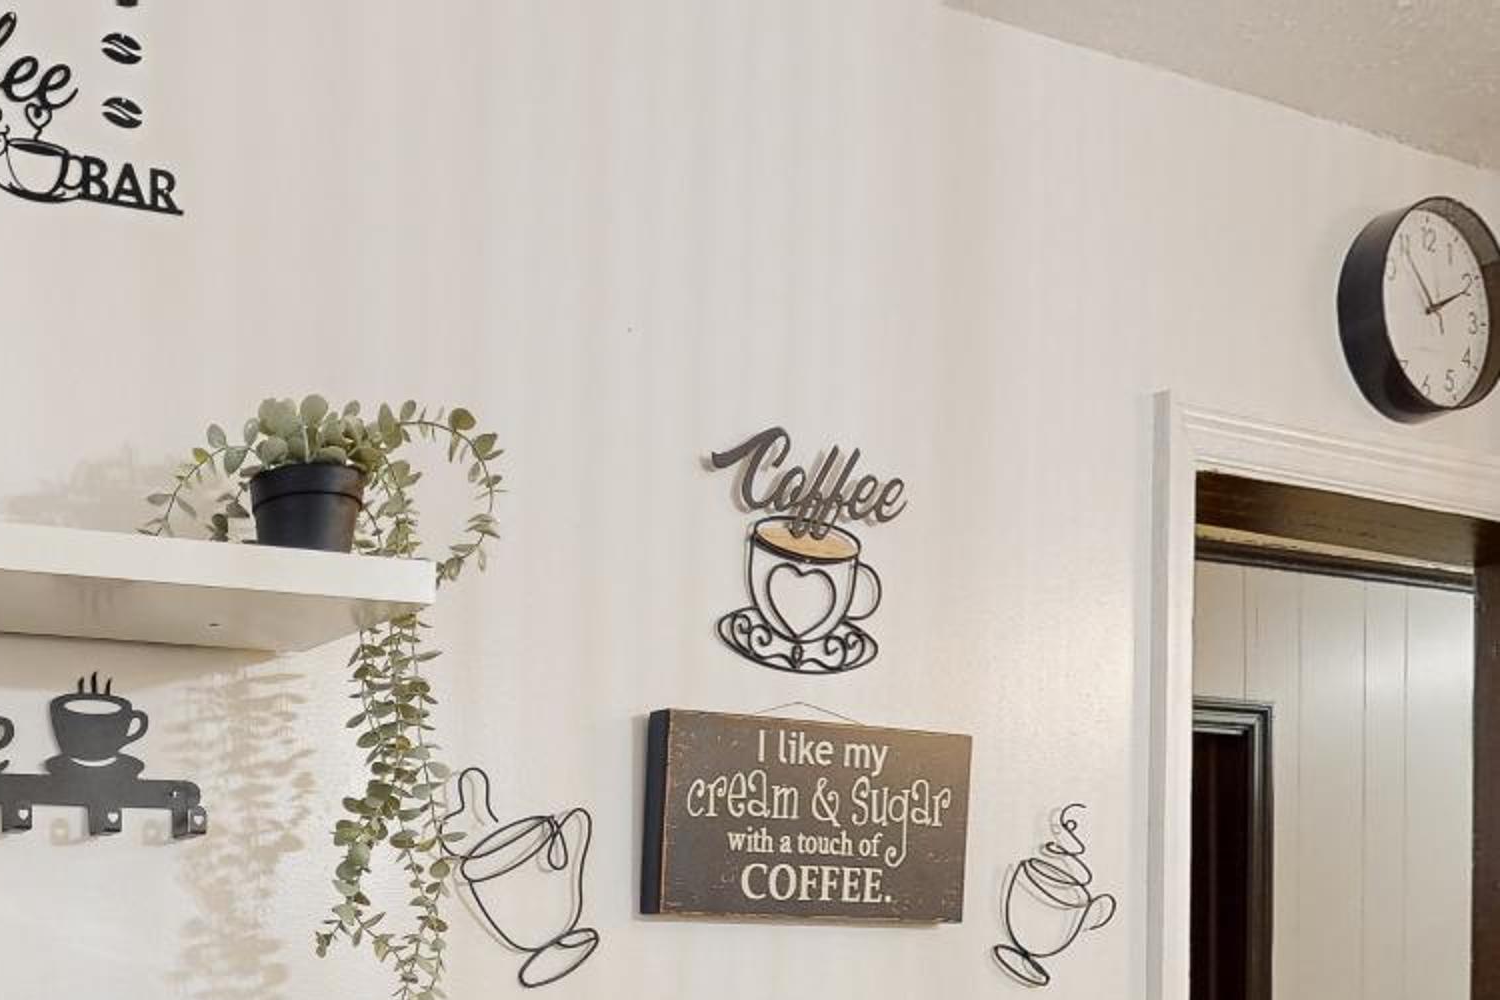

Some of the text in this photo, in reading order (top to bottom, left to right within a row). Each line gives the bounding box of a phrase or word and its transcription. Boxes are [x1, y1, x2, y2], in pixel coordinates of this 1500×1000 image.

[82, 156, 183, 211] BAR
[1468, 312, 1479, 335] 3
[1461, 347, 1472, 369] 4
[1445, 369, 1456, 393] 5
[712, 427, 908, 540] Coffee
[758, 729, 888, 777] I like my
[687, 769, 799, 820] cream
[811, 777, 841, 828] &
[727, 826, 884, 857] with a touch of
[741, 863, 892, 904] COFFEE.
